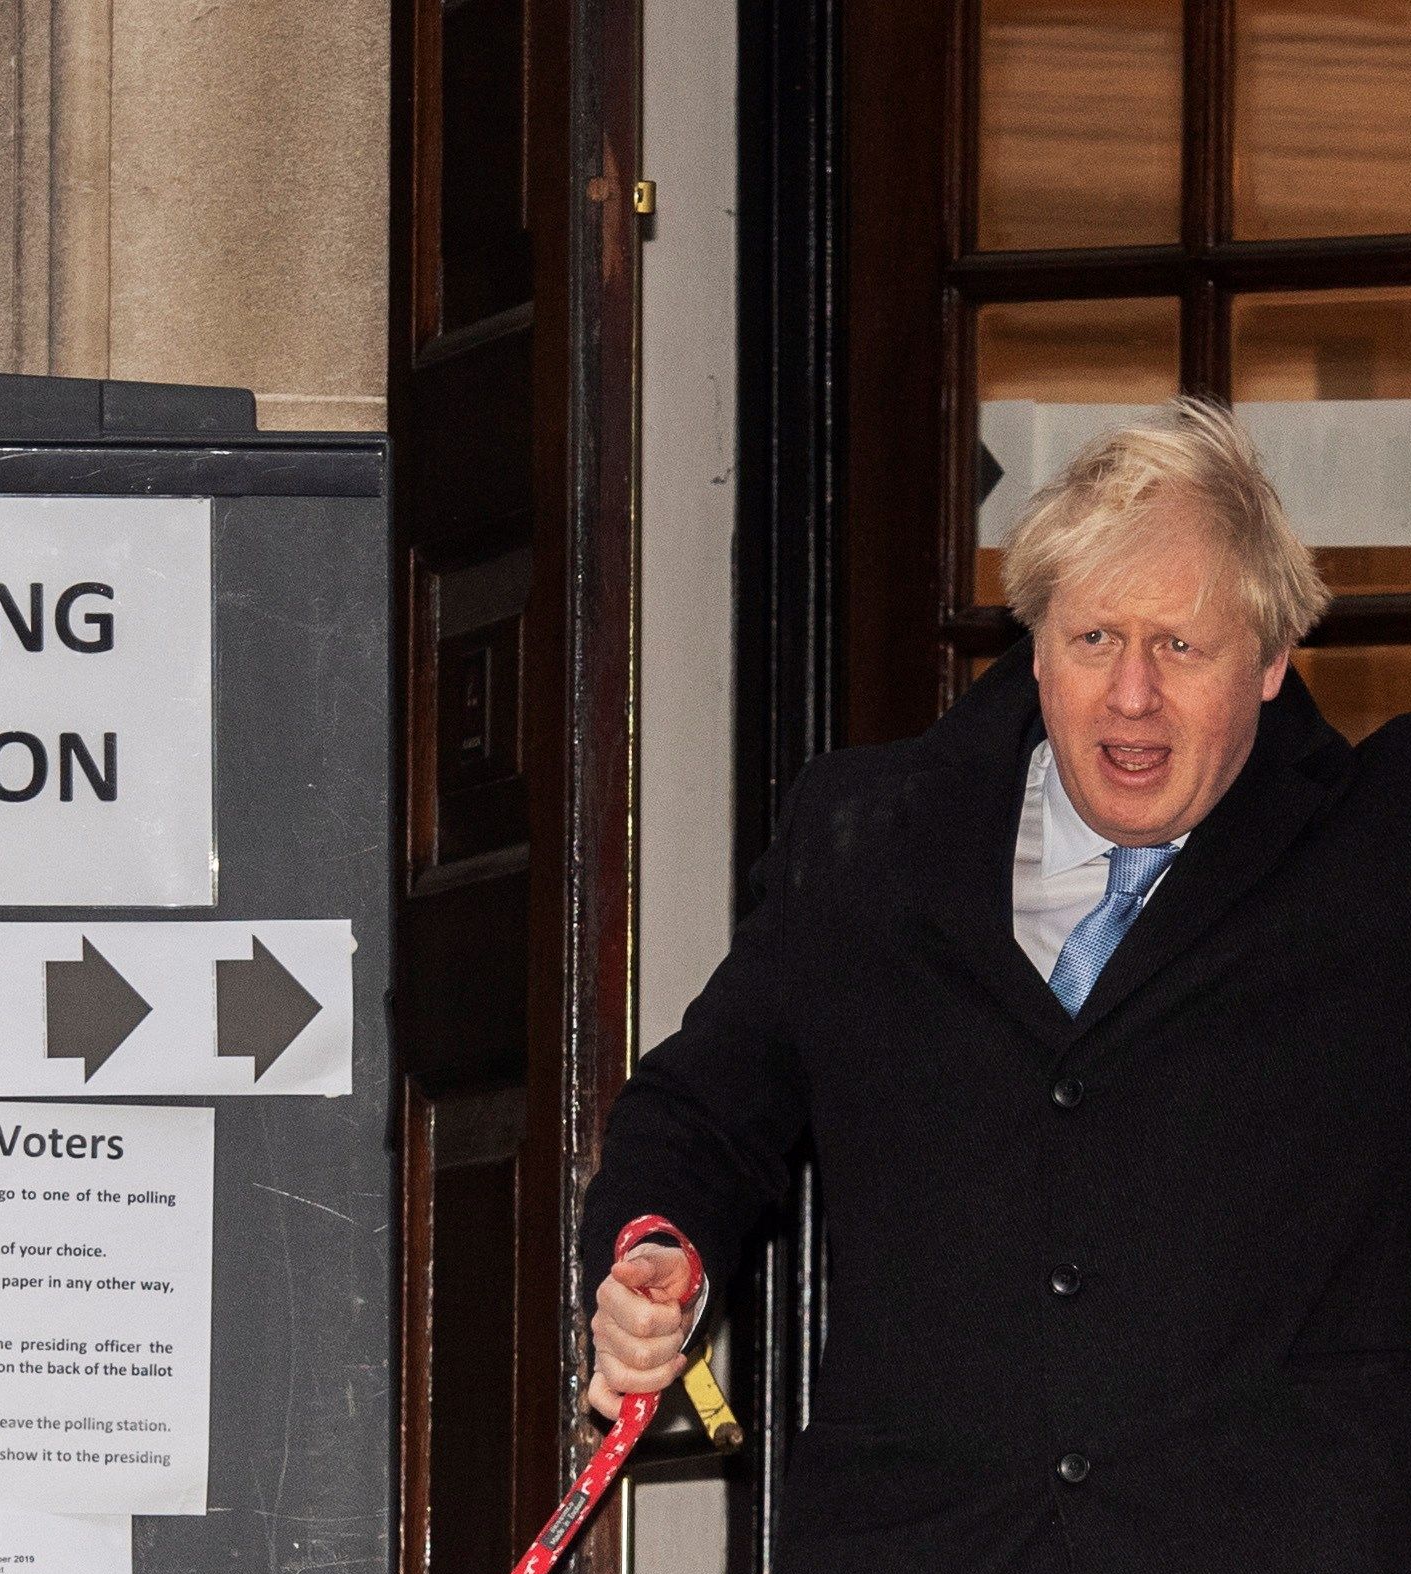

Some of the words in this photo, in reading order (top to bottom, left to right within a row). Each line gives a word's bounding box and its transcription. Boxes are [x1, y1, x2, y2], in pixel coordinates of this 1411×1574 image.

[21, 1188, 37, 1201] to
[42, 1190, 70, 1202] one
[76, 1188, 91, 1202] of
[96, 1189, 121, 1203] the
[127, 1190, 177, 1208] polling
[0, 1241, 16, 1255] of
[19, 1245, 53, 1258] your
[56, 1243, 107, 1258] choice.
[1, 1277, 44, 1290] paper
[48, 1275, 62, 1288] in
[65, 1278, 93, 1292] any
[96, 1276, 136, 1291] other
[140, 1281, 174, 1294] way,
[20, 1338, 88, 1355] presiding
[94, 1339, 141, 1354] officer
[149, 1340, 174, 1354] the
[18, 1361, 43, 1375] the
[46, 1361, 80, 1375] back
[84, 1362, 100, 1376] of
[102, 1362, 127, 1377] the
[130, 1363, 173, 1378] ballot
[36, 1416, 61, 1430] the
[64, 1416, 114, 1434] polling
[116, 1419, 171, 1433] station.
[0, 1447, 38, 1461] show
[42, 1449, 53, 1462] it
[56, 1450, 72, 1463] to
[75, 1449, 100, 1463] the
[104, 1450, 171, 1468] presiding
[13, 1554, 35, 1563] 2019
